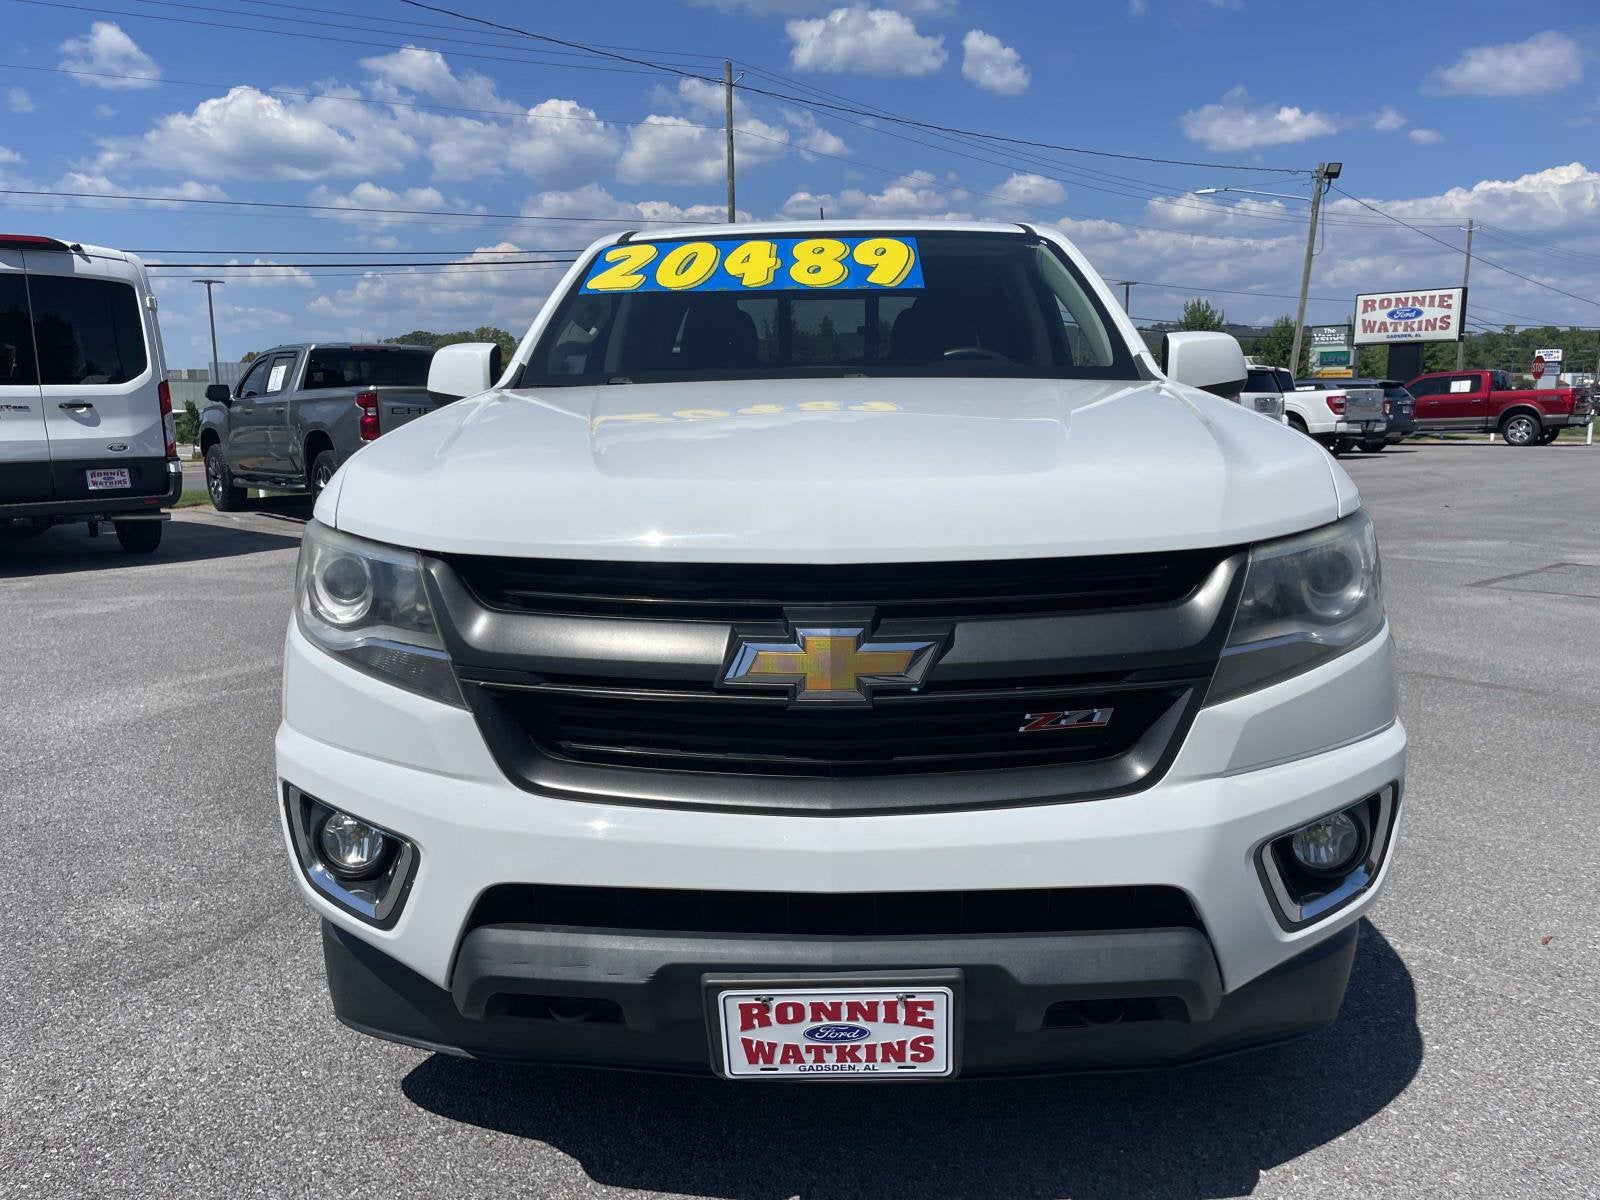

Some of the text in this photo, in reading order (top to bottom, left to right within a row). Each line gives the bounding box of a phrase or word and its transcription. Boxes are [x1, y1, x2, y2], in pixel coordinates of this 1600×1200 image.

[586, 237, 916, 290] 20489
[1362, 294, 1453, 314] RONNIE
[1393, 309, 1417, 319] Ford
[1362, 314, 1451, 334] WATKINS
[1313, 333, 1346, 341] Venue
[1532, 362, 1545, 373] STOP
[90, 471, 127, 479] RONNIE
[91, 478, 128, 487] WATKINS
[1019, 708, 1114, 732] Z71
[738, 999, 935, 1032] RONNIE
[814, 1025, 860, 1039] Ford
[740, 1035, 935, 1065] WATKINS
[798, 1063, 879, 1073] GADSDEN, AL
